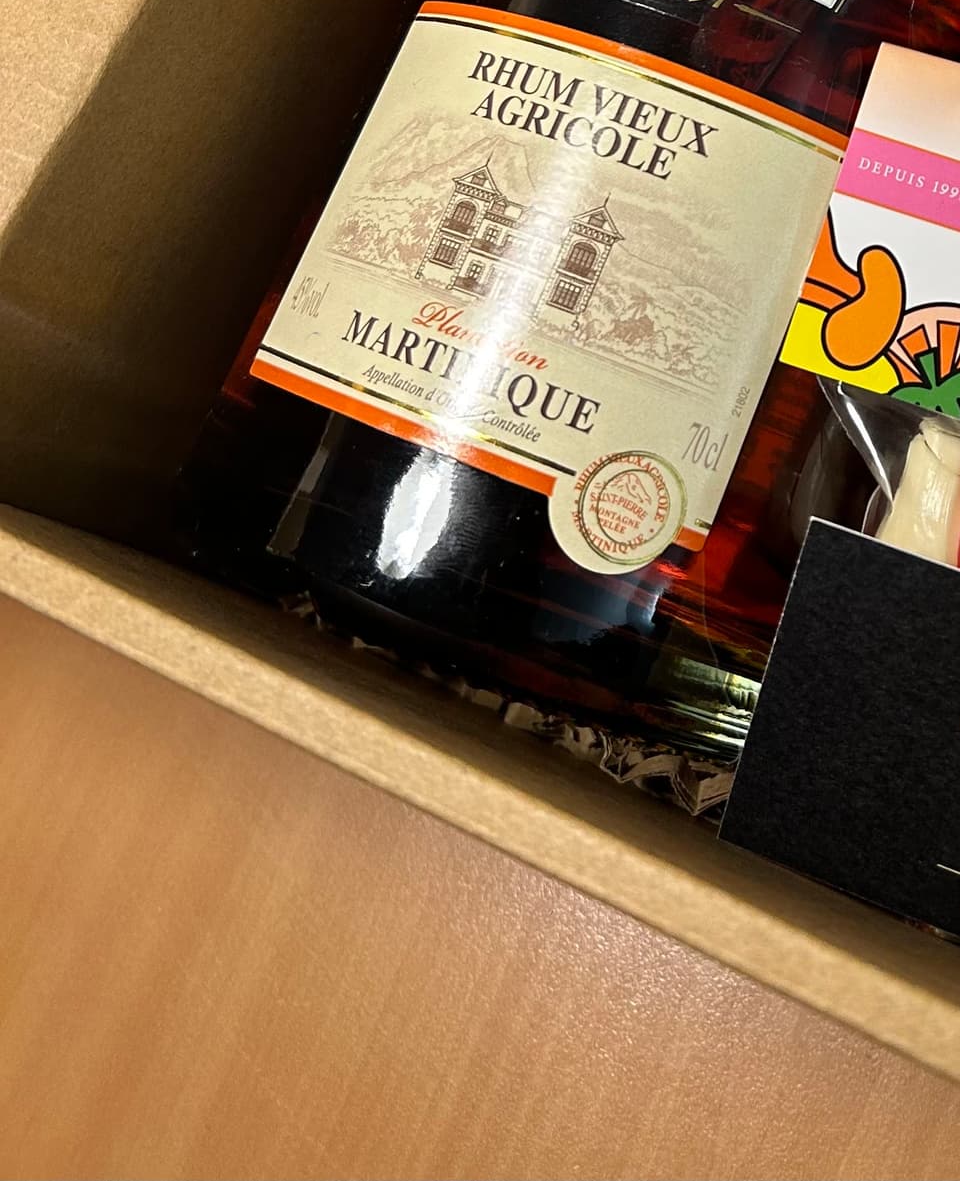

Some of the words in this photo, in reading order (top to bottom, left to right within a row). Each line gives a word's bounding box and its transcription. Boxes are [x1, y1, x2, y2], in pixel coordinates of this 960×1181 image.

[468, 50, 585, 108] RHUM
[592, 82, 719, 158] VIEUX
[471, 89, 677, 181] AGRICOLE
[858, 156, 926, 189] DEPUIS
[342, 309, 602, 434] MARTIIQUE
[362, 364, 425, 398] Appellation
[481, 409, 543, 443] Contrôlée
[682, 421, 729, 472] 70cl
[589, 504, 641, 530] MONTAGNE
[590, 491, 648, 521] SAINT-PIERRE
